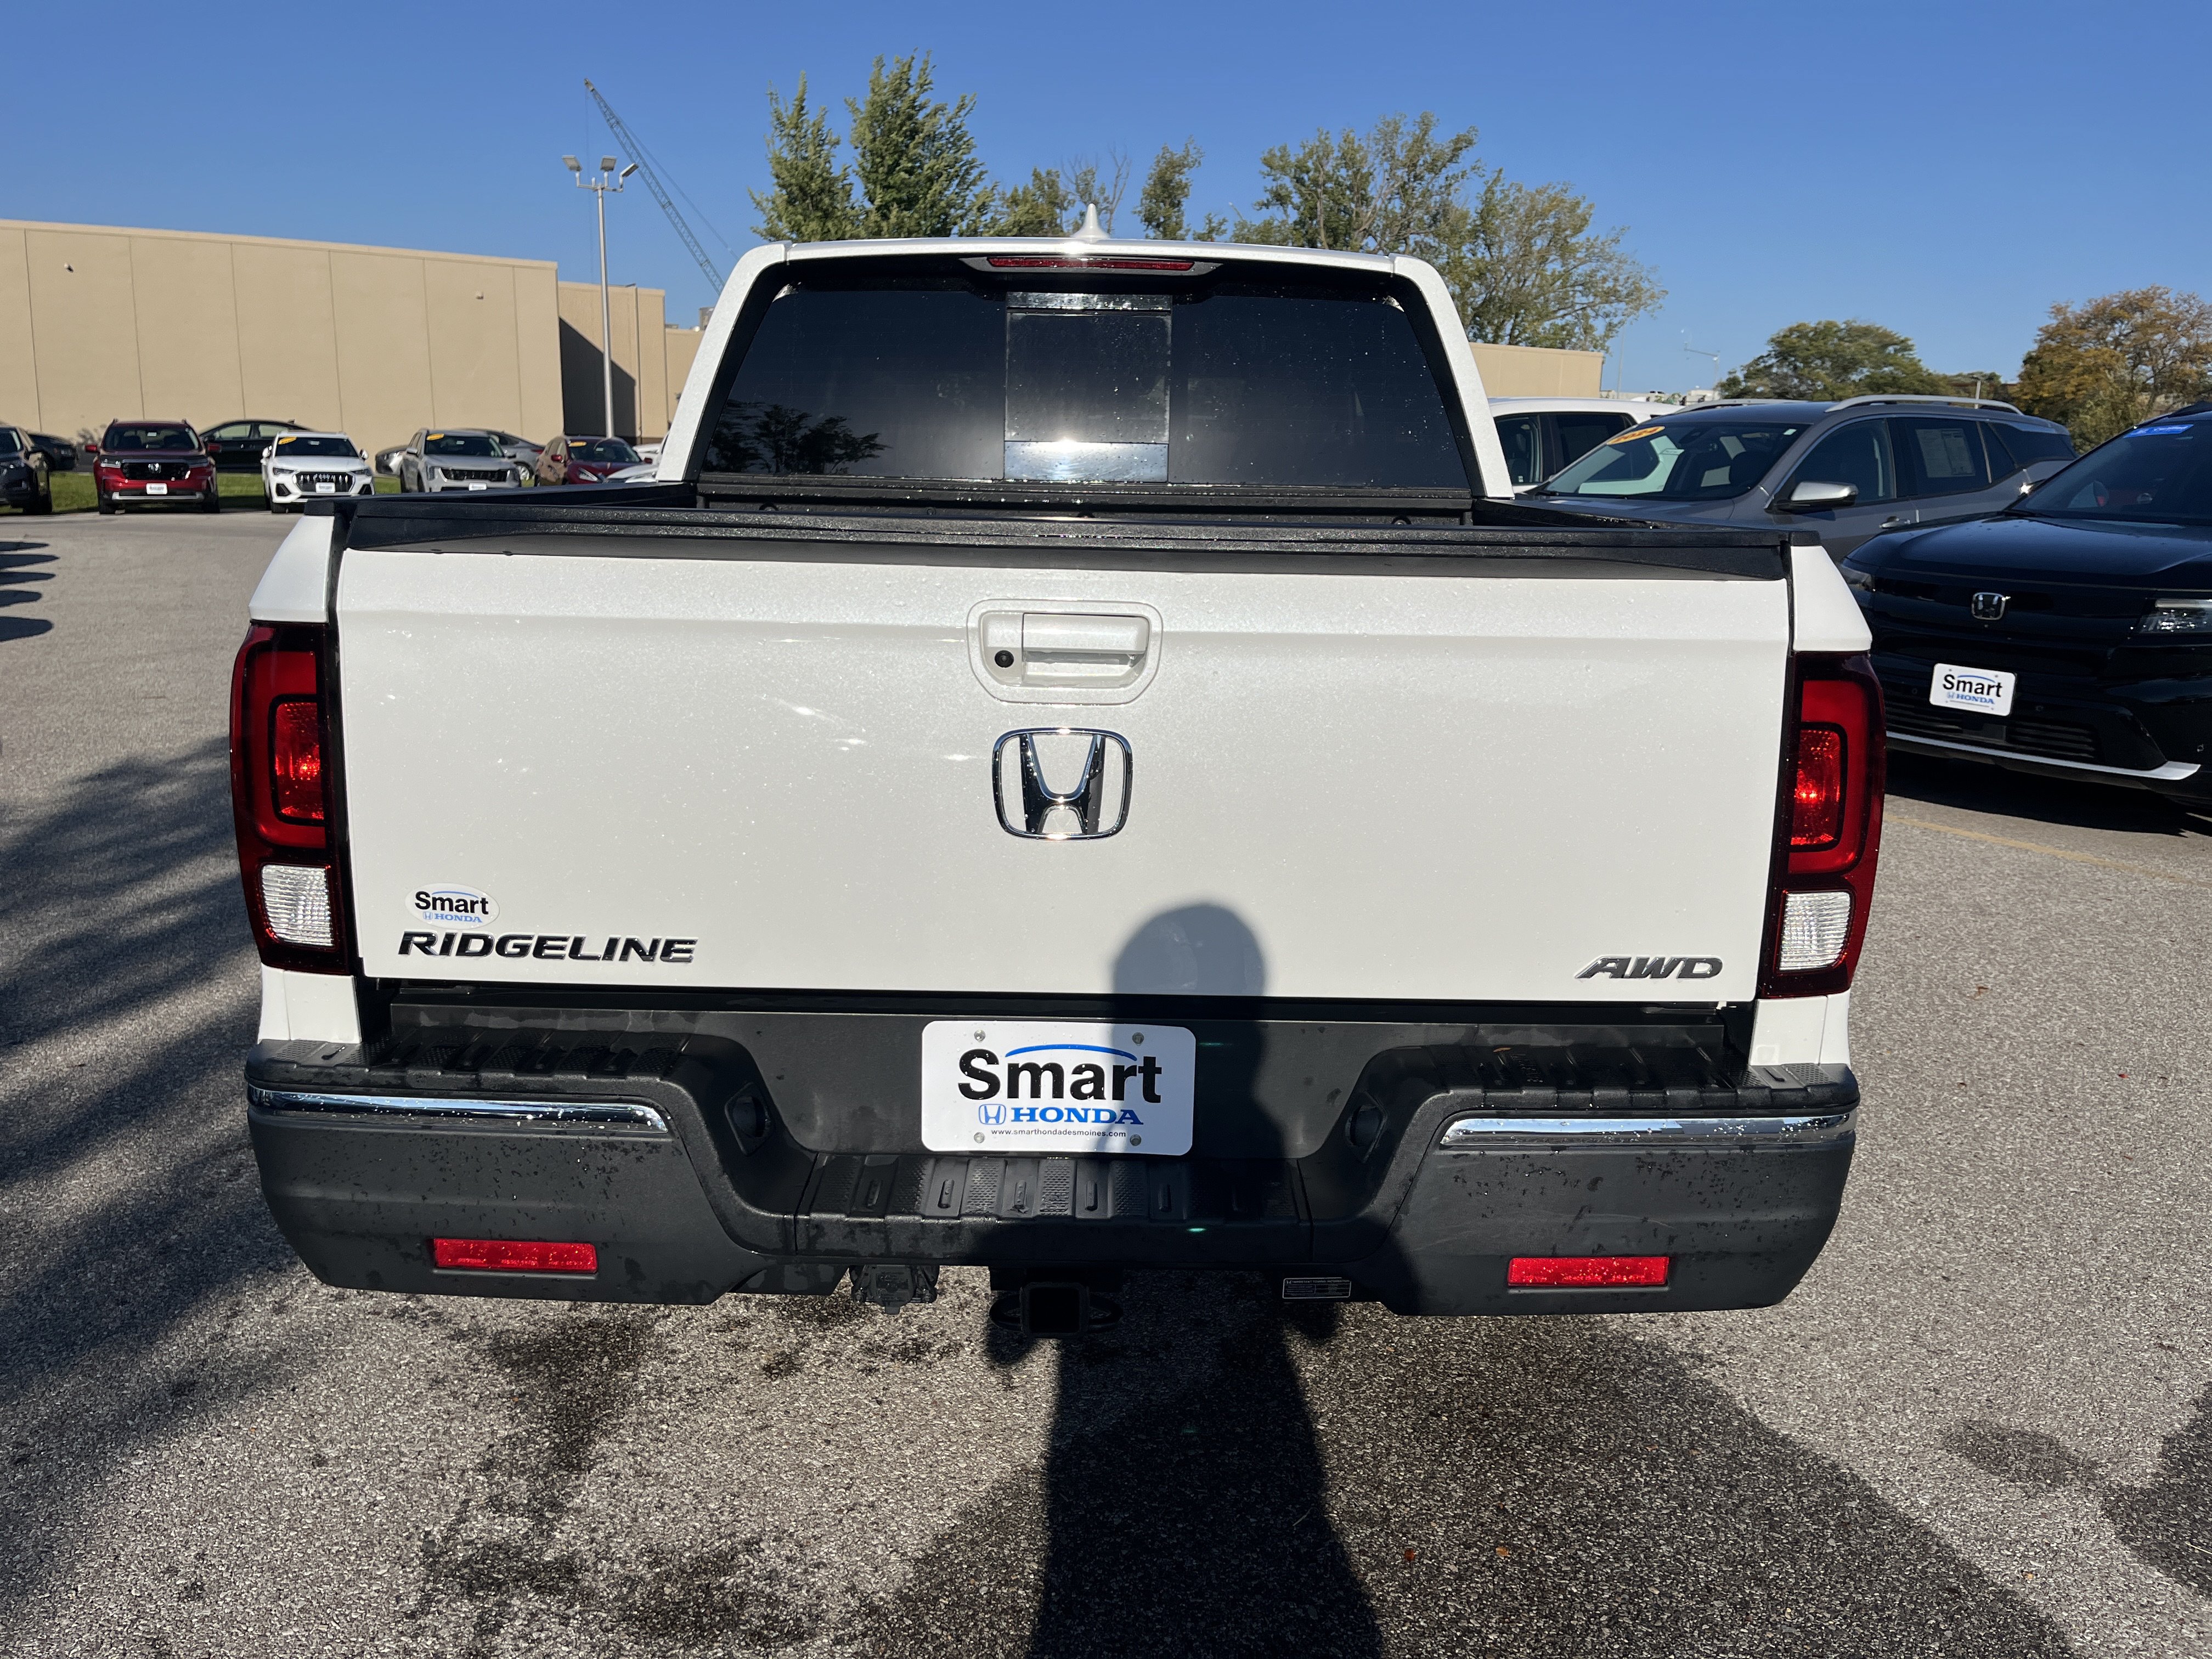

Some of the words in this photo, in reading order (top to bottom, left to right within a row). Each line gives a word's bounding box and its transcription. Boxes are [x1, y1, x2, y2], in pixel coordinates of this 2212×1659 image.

[1943, 674, 2003, 697] Smart
[1956, 693, 1995, 704] HONDA
[415, 891, 489, 915] Smart
[435, 913, 483, 923] HONDA
[398, 931, 699, 963] RIDGELINE
[1575, 956, 1723, 979] AWD
[958, 1047, 1163, 1103] Smart
[1011, 1107, 1144, 1125] HONDA
[991, 1128, 1127, 1138] www.smarthondadesmoines.com
